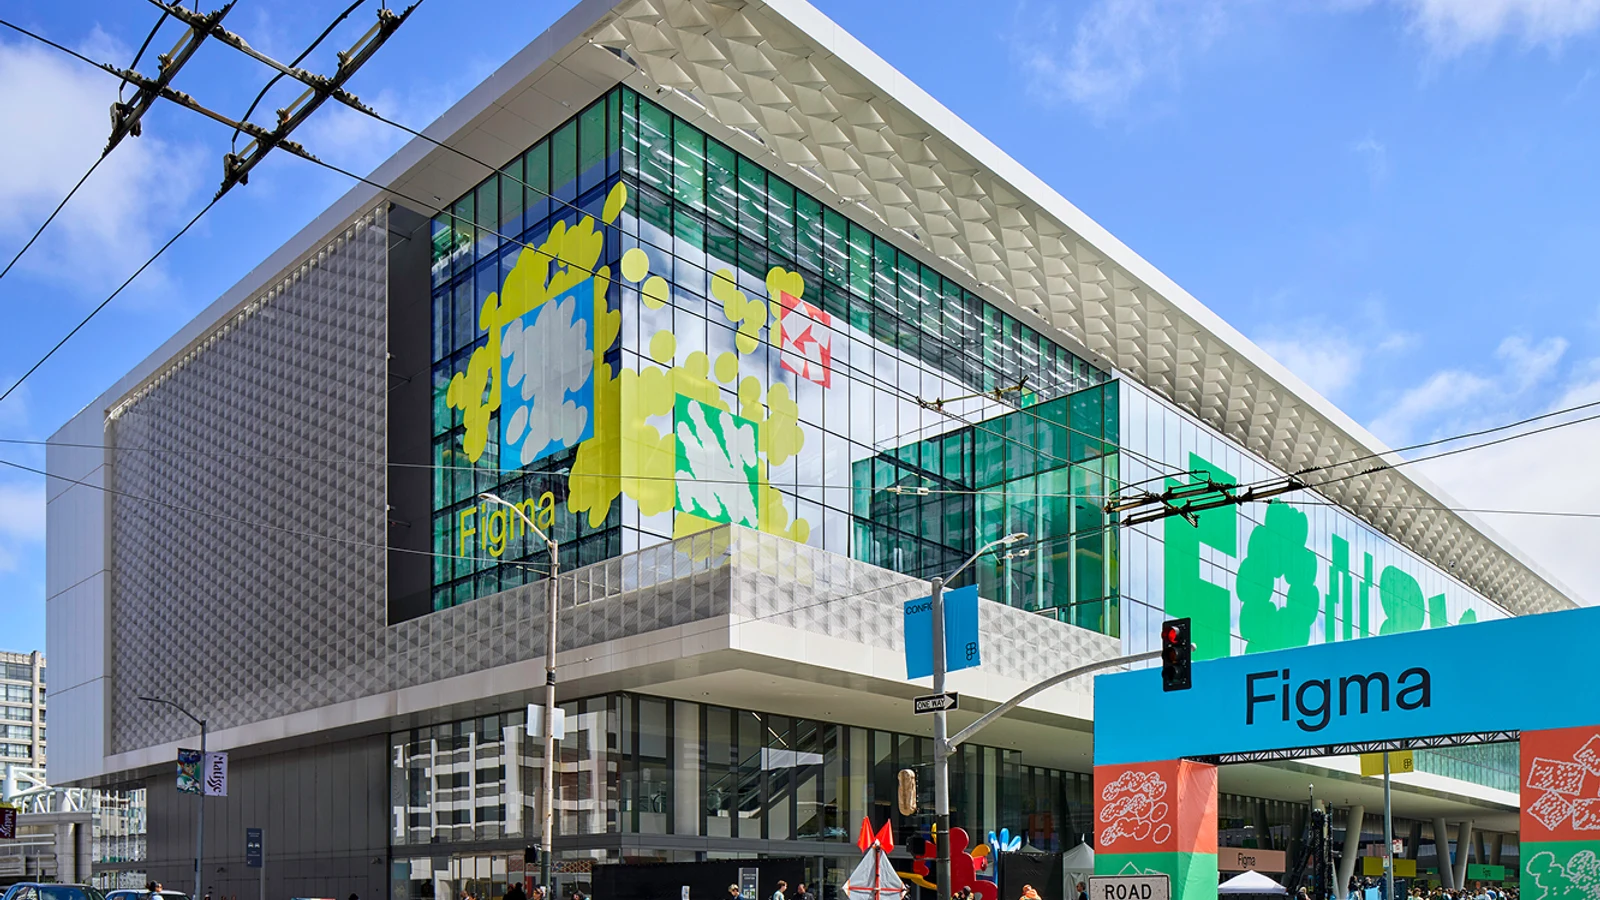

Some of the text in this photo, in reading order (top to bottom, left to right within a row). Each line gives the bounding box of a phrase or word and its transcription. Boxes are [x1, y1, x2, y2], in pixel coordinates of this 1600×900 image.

[460, 491, 554, 557] Figma
[917, 698, 945, 709] ONE WAY
[1246, 667, 1431, 732] Figma
[206, 755, 224, 793] Matisse
[1237, 852, 1256, 868] Figma
[1105, 884, 1152, 900] ROAD
